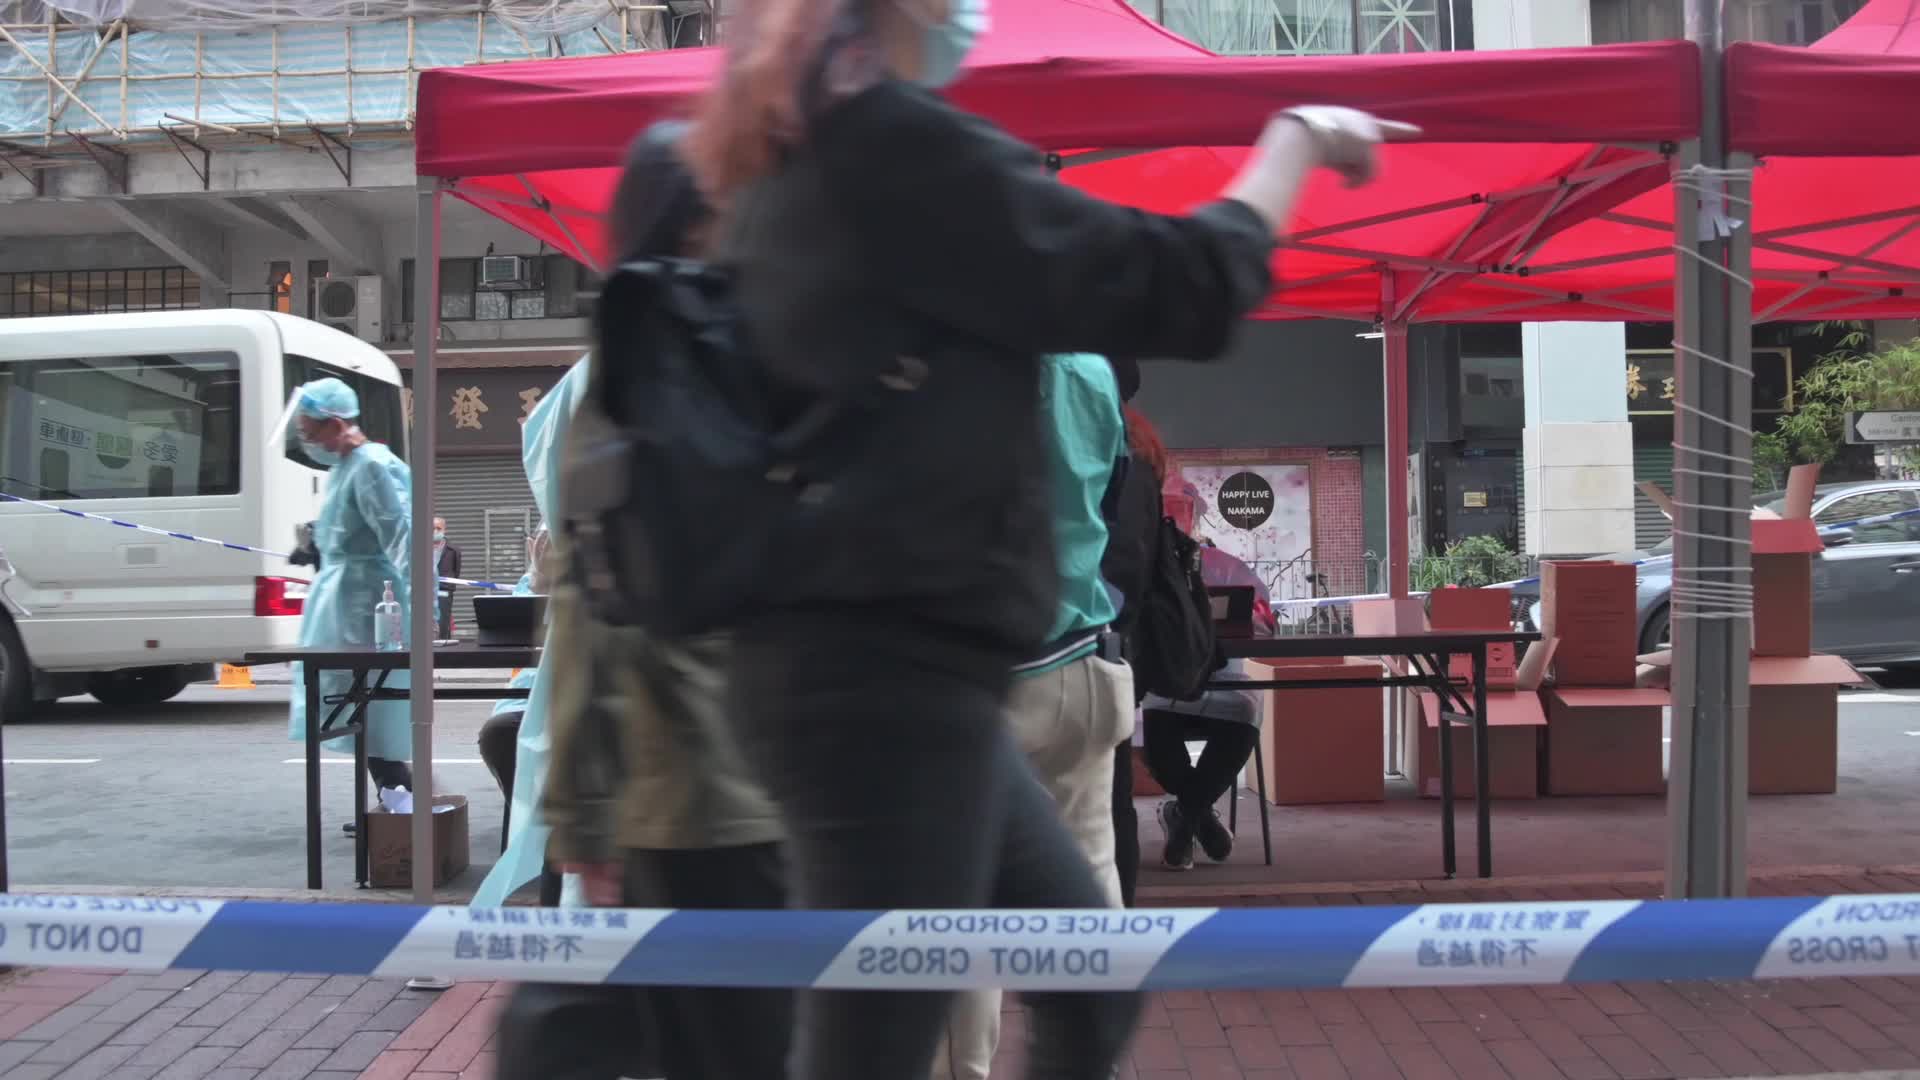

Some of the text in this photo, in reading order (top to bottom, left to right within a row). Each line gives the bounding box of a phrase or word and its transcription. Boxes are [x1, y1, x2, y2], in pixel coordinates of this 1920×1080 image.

[1222, 490, 1270, 499] HAPPY LIVE
[1227, 506, 1265, 515] NAKAMA
